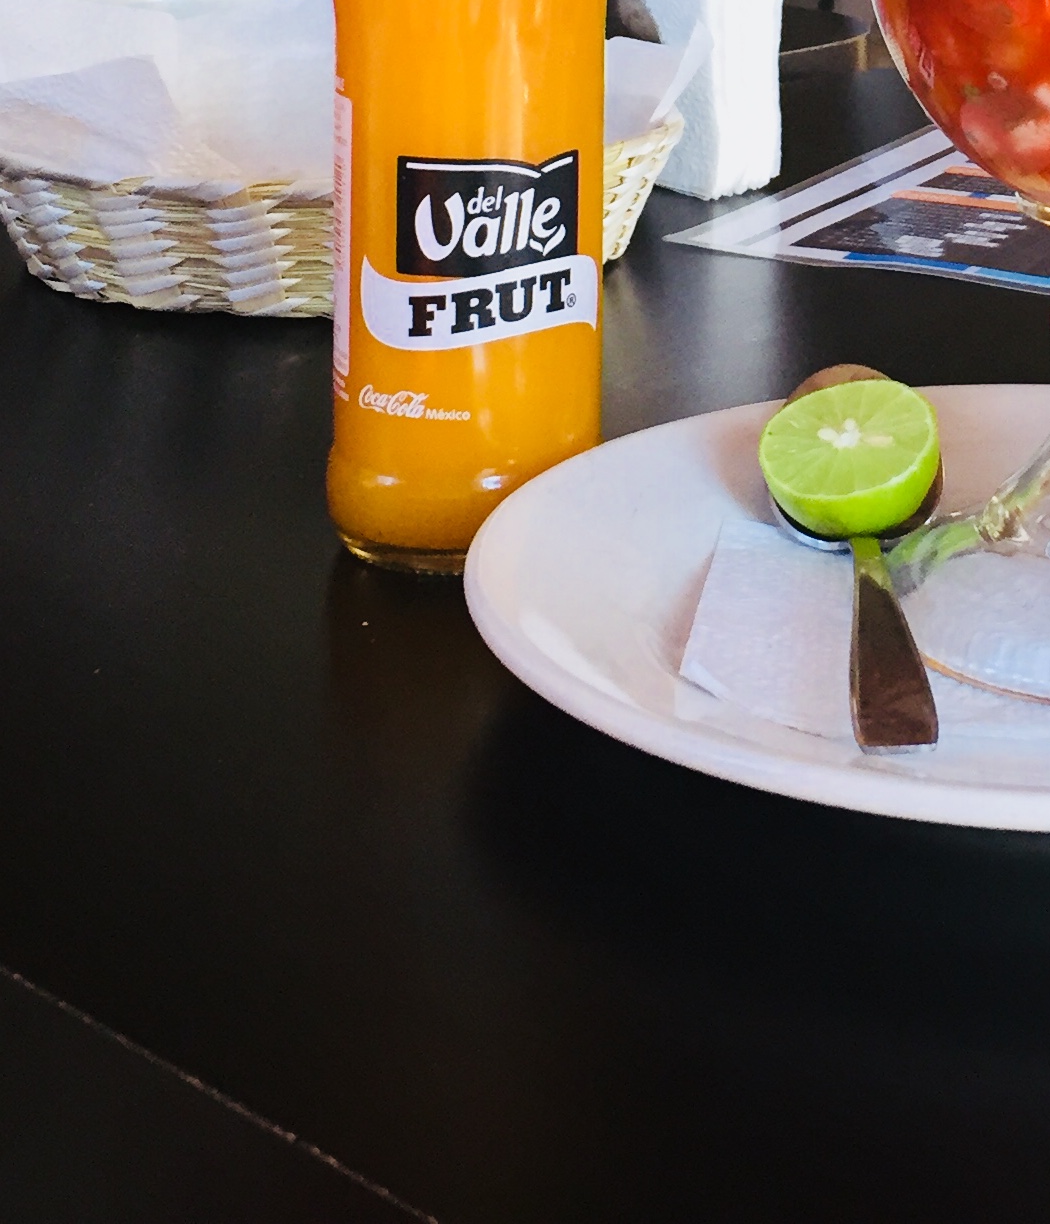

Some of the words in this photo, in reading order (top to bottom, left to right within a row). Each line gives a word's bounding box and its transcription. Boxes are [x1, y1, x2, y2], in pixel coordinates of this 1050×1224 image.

[467, 185, 503, 215] del
[415, 187, 565, 261] Valle
[358, 384, 430, 418] Coca-Cola
